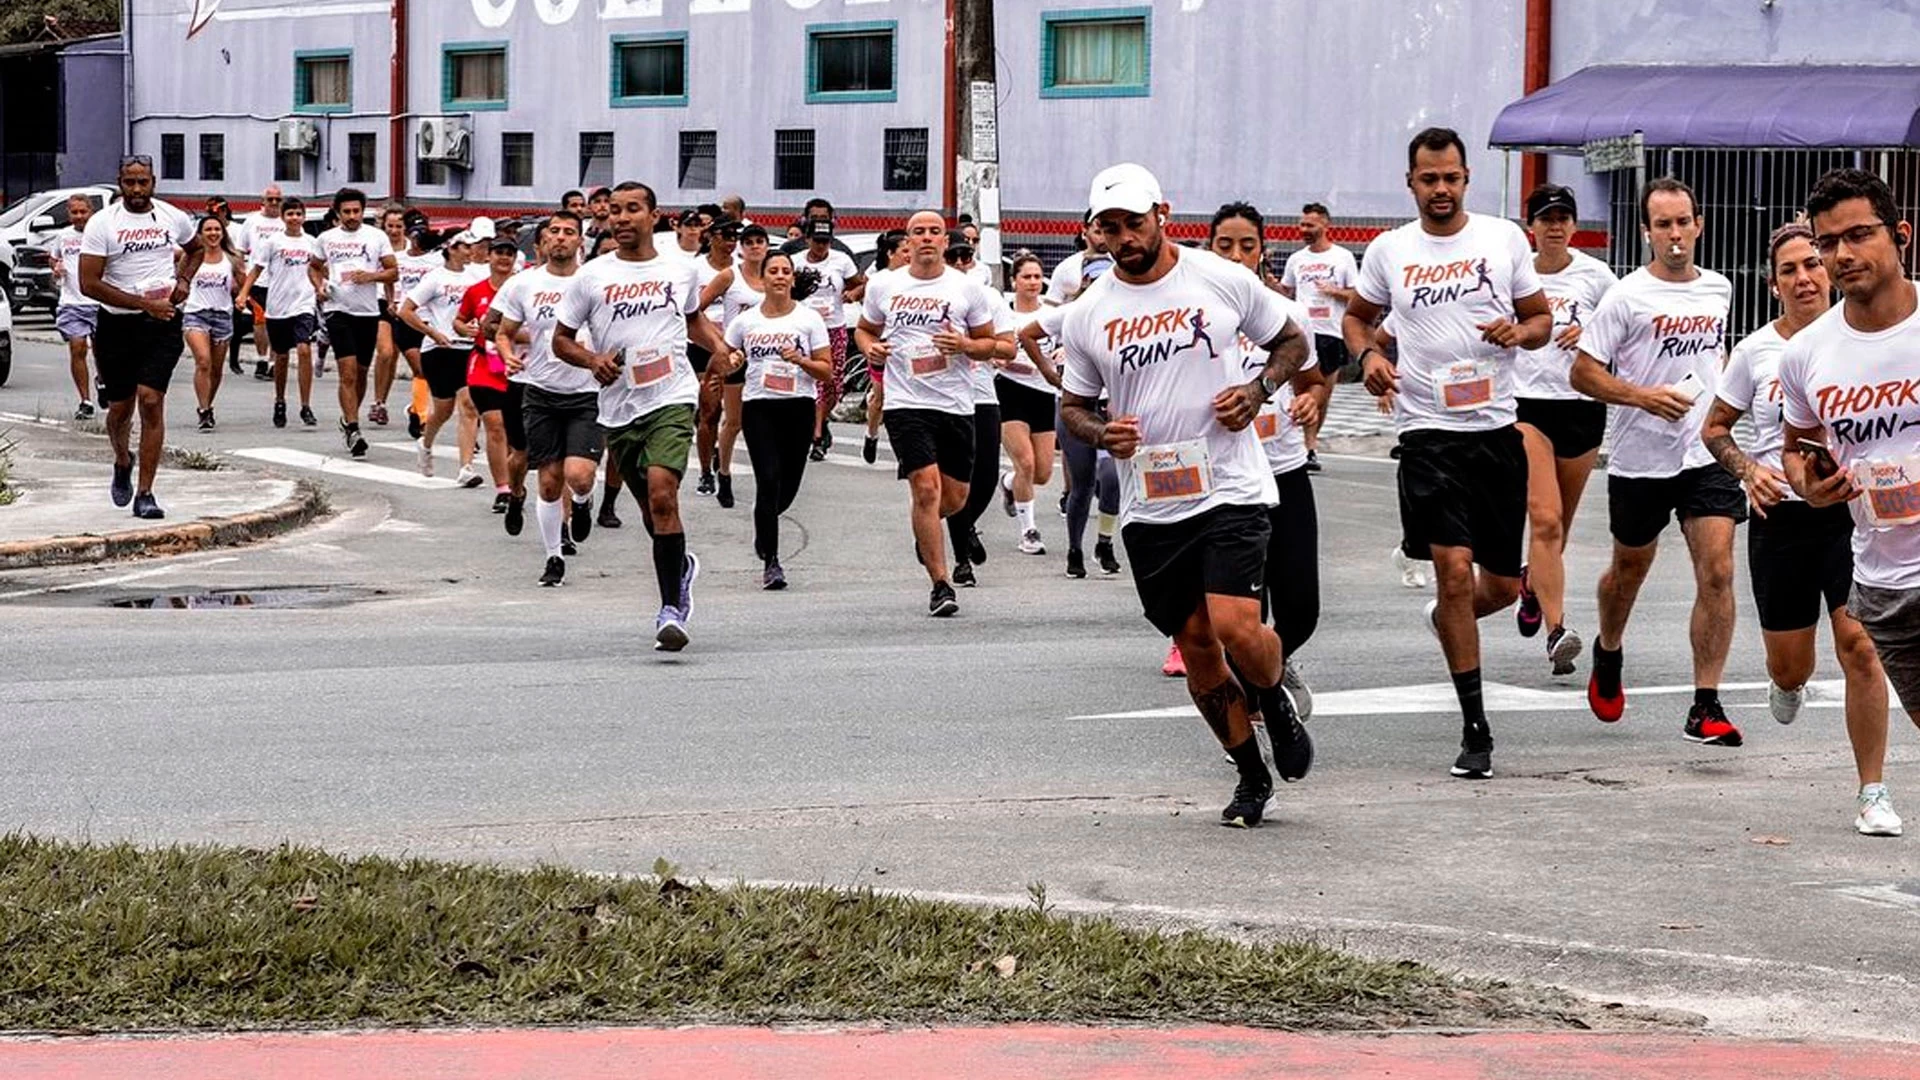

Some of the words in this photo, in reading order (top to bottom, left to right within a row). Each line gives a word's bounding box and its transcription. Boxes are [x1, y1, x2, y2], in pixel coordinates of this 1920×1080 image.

[117, 227, 163, 243] THORK
[122, 241, 154, 255] RUN
[1403, 258, 1477, 288] THORK
[533, 291, 562, 308] THO
[604, 281, 664, 305] THORK
[890, 294, 944, 312] THORK
[1411, 283, 1461, 309] RUN
[536, 304, 556, 321] RU
[612, 300, 652, 322] RUN
[894, 311, 930, 327] RUN
[1104, 307, 1191, 352] THORK
[1652, 314, 1717, 339] THORK
[746, 333, 794, 346] THORK
[1657, 337, 1702, 360] RUN
[750, 345, 783, 358] RUN
[1119, 338, 1173, 375] RUN
[1816, 378, 1920, 421] THORK
[1831, 412, 1898, 446] RUN
